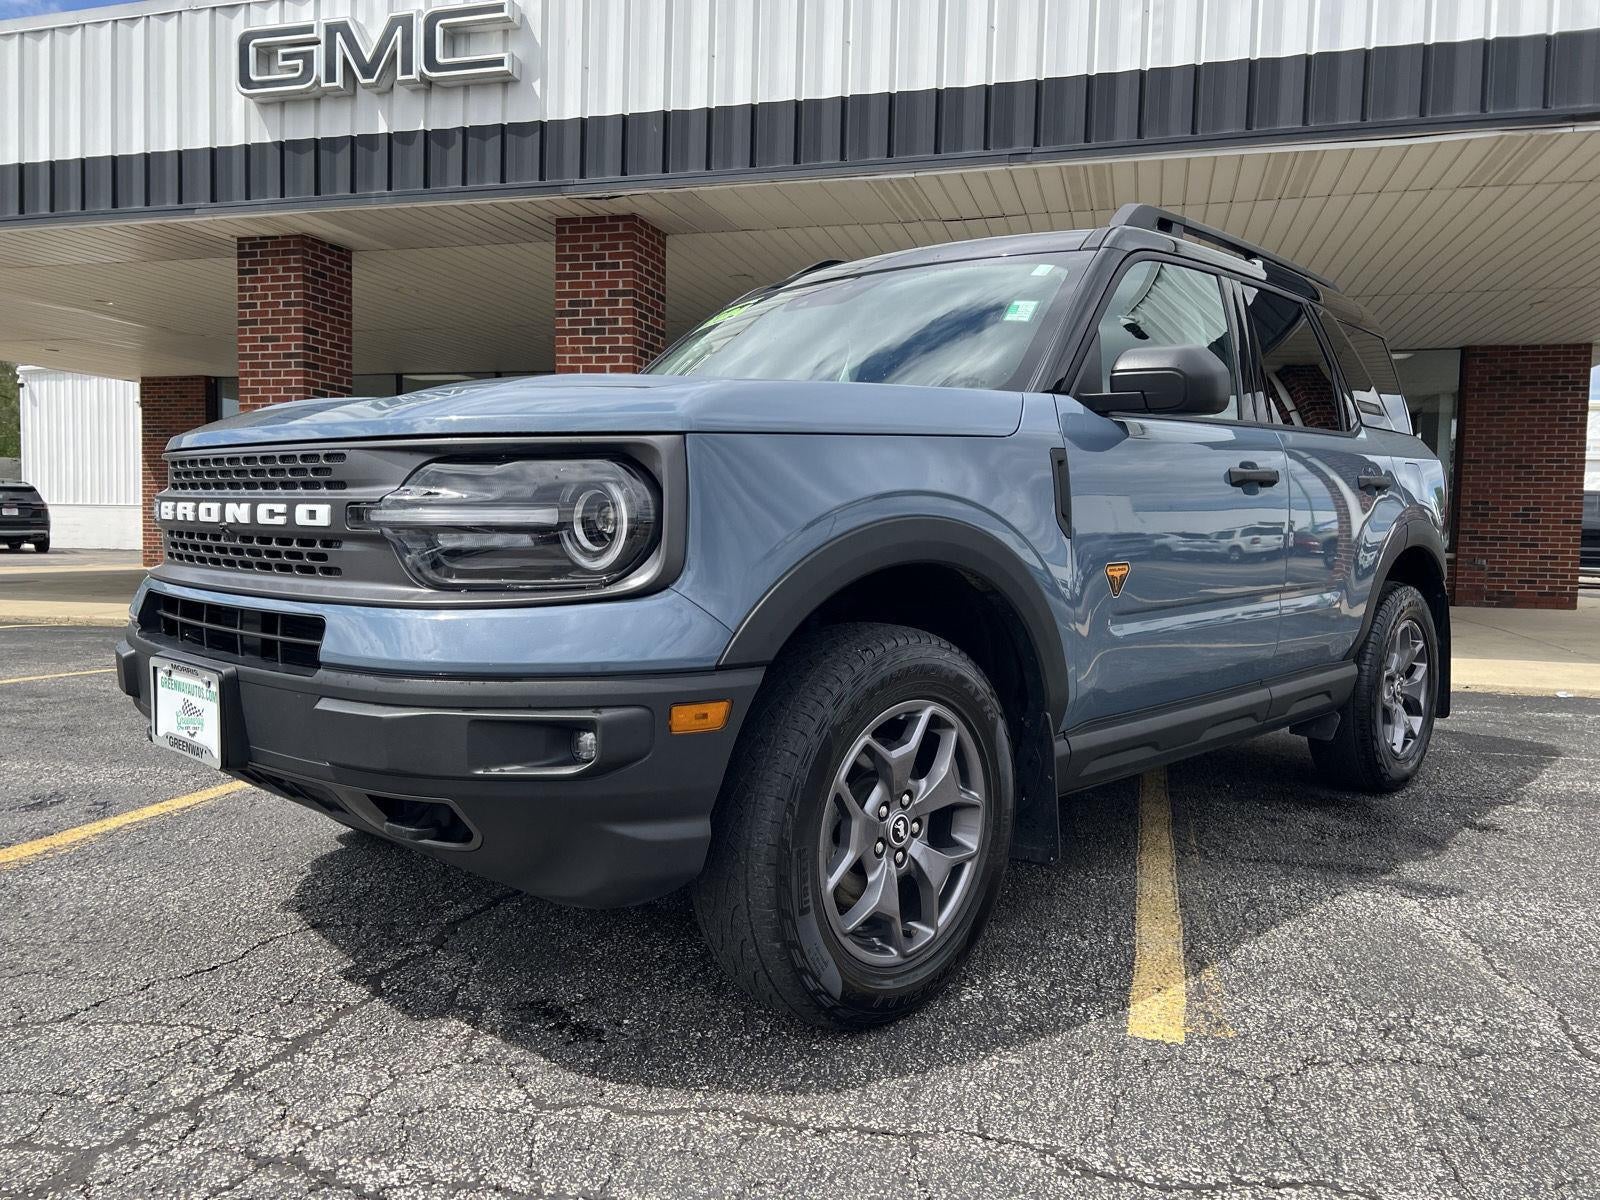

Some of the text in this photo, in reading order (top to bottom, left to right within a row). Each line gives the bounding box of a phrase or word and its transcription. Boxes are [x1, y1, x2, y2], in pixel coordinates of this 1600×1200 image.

[236, 1, 518, 99] GMC
[160, 501, 331, 526] BRONCO
[170, 663, 199, 676] MORRIS
[168, 736, 204, 759] GREENWAY
